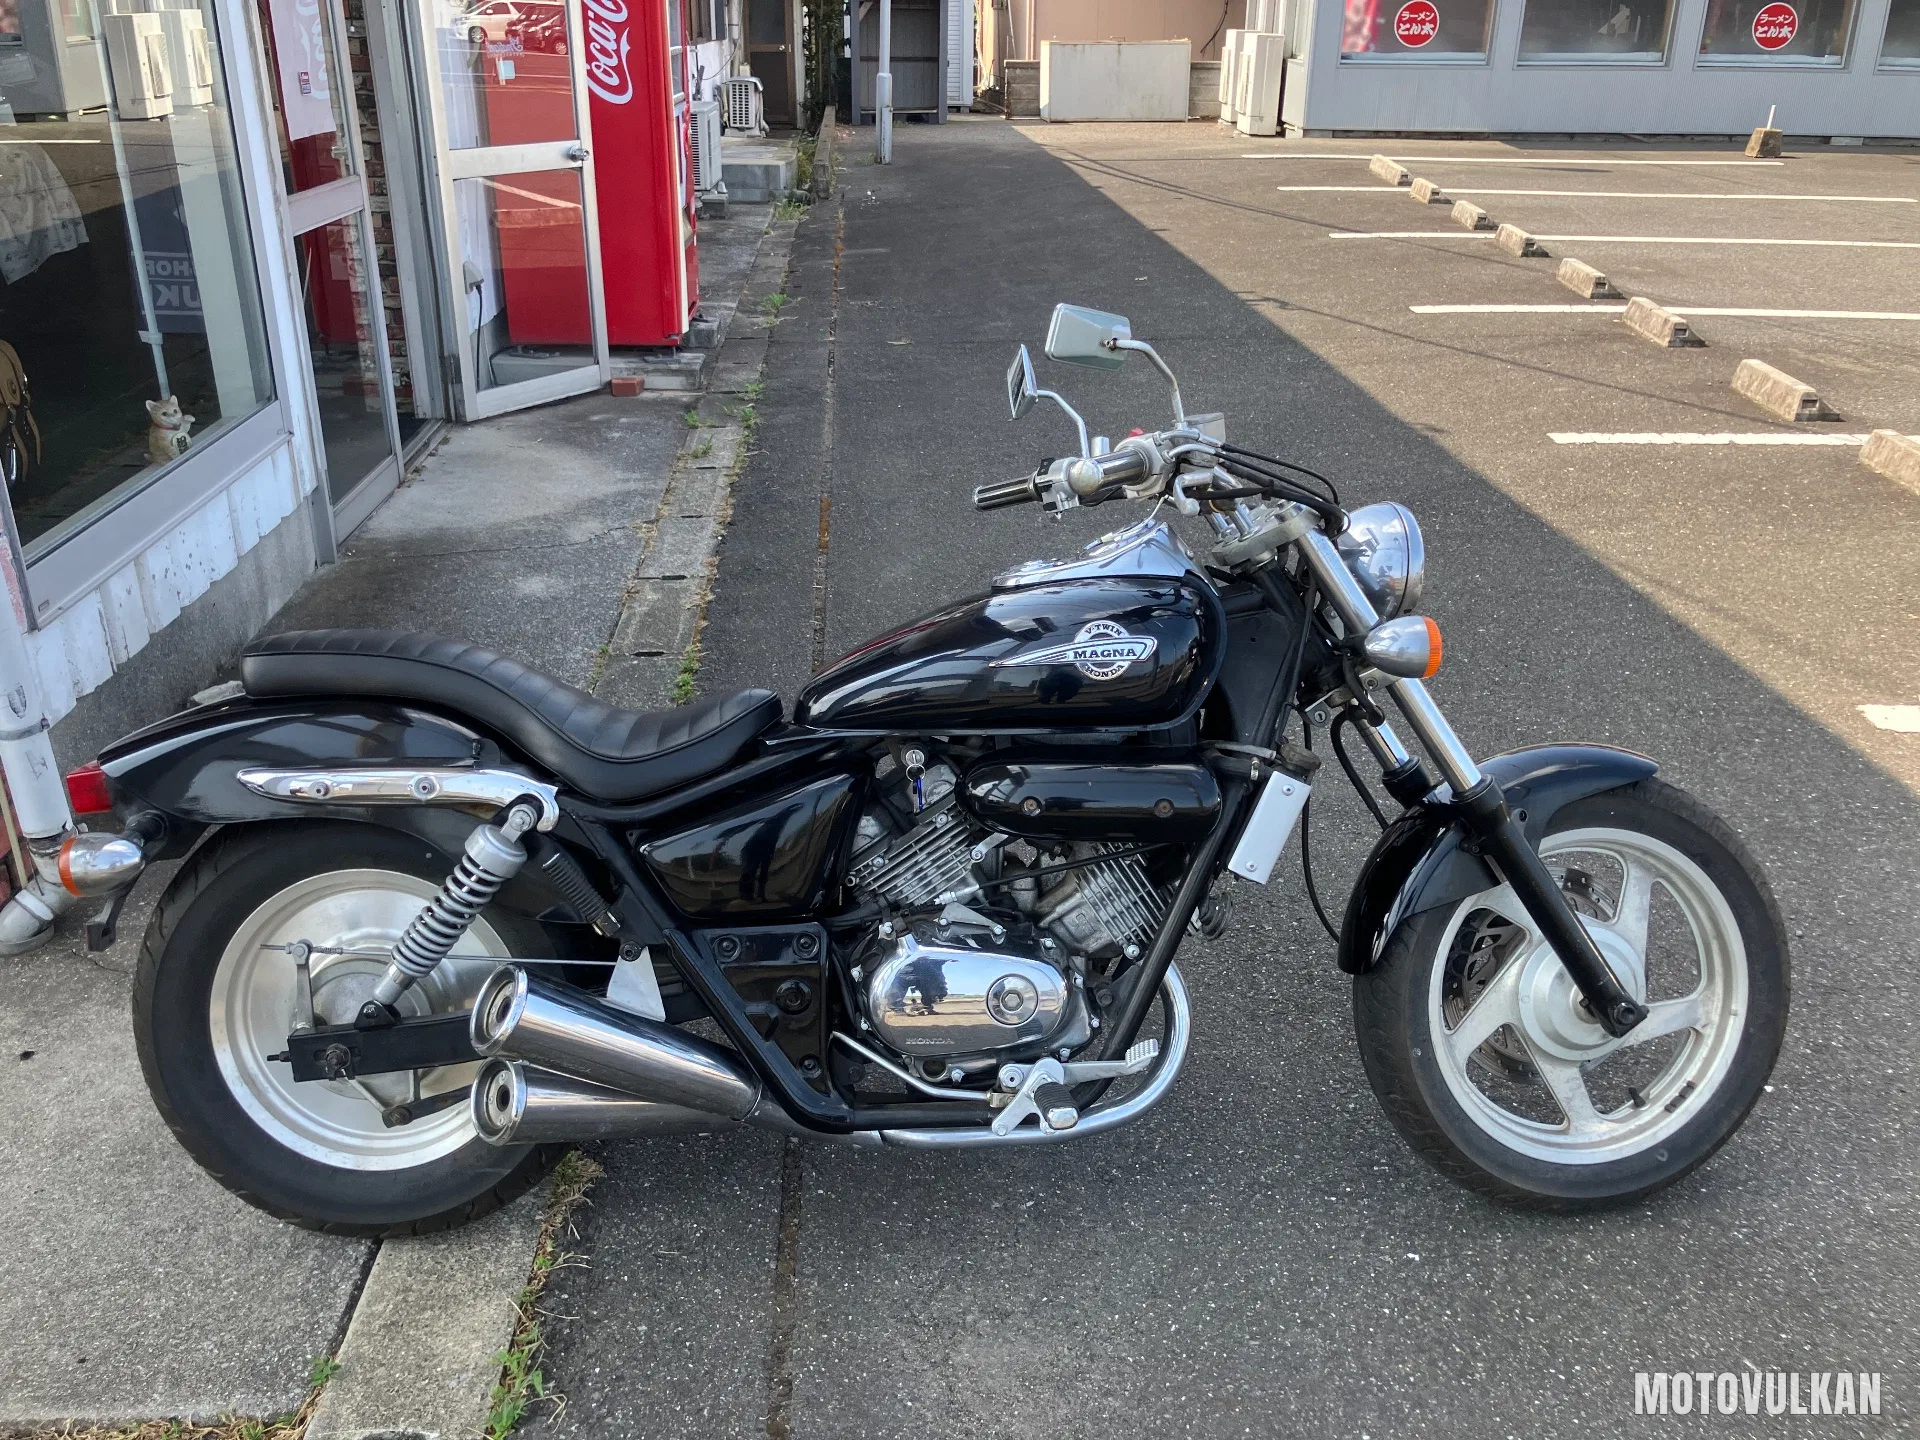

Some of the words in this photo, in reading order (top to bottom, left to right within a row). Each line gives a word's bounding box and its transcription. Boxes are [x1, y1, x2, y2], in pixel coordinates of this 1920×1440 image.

[1401, 11, 1435, 21] ラーメン
[1760, 13, 1794, 24] ラーメン
[1398, 22, 1435, 36] とん太
[1755, 25, 1793, 38] とん太
[1073, 648, 1138, 660] MAGNA
[1085, 664, 1125, 678] HONDA
[904, 1037, 956, 1045] HONDA
